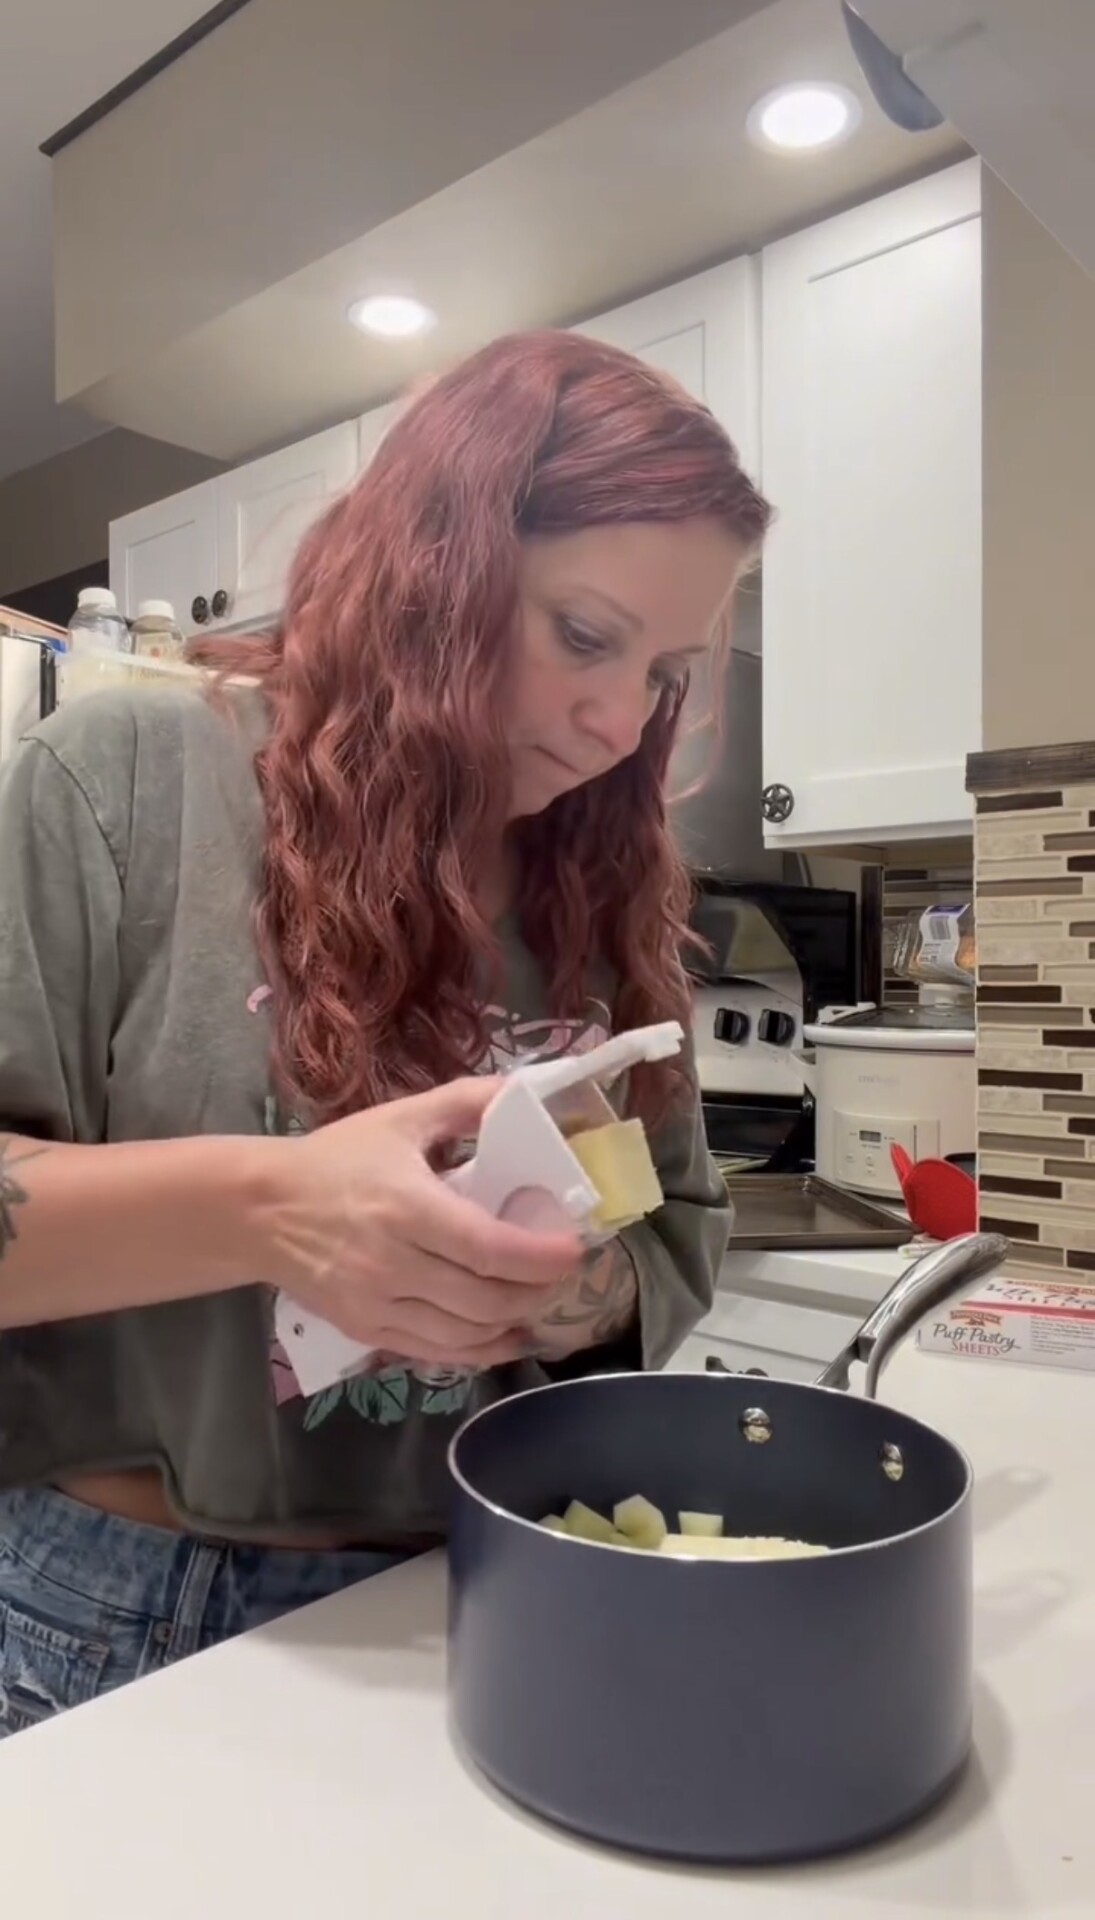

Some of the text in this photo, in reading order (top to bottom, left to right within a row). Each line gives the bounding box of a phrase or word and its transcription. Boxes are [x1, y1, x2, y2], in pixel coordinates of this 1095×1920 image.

[933, 1323, 968, 1341] Puff
[970, 1327, 1021, 1353] Pastry
[952, 1341, 1000, 1356] SHEETS
